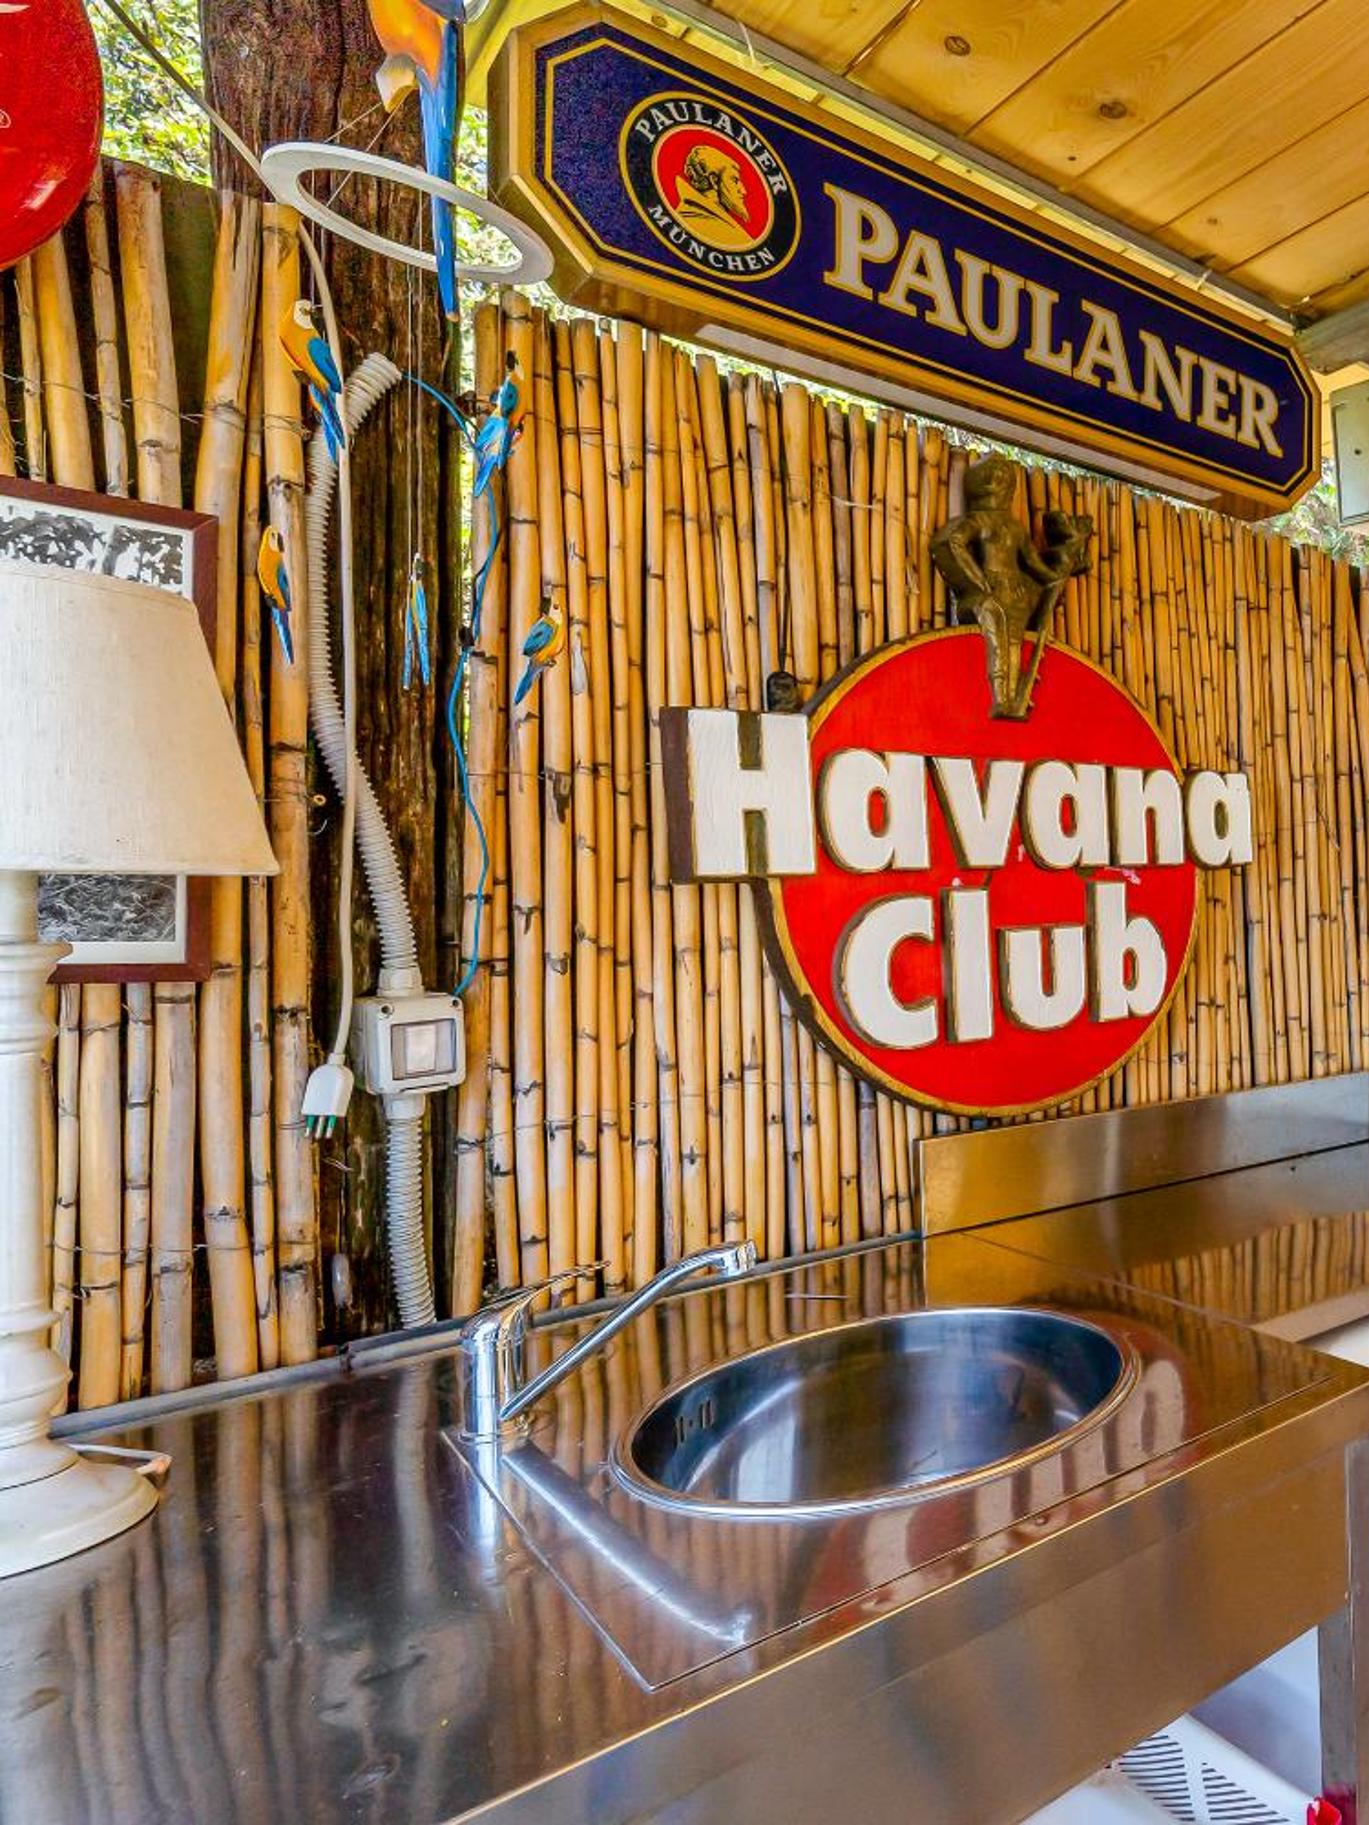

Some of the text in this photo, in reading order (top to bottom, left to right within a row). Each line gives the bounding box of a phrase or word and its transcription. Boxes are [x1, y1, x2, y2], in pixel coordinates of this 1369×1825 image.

[635, 102, 788, 195] PAULANER
[822, 182, 1284, 459] PAULANER
[685, 707, 1254, 874] Havana
[841, 880, 1168, 1050] Club
